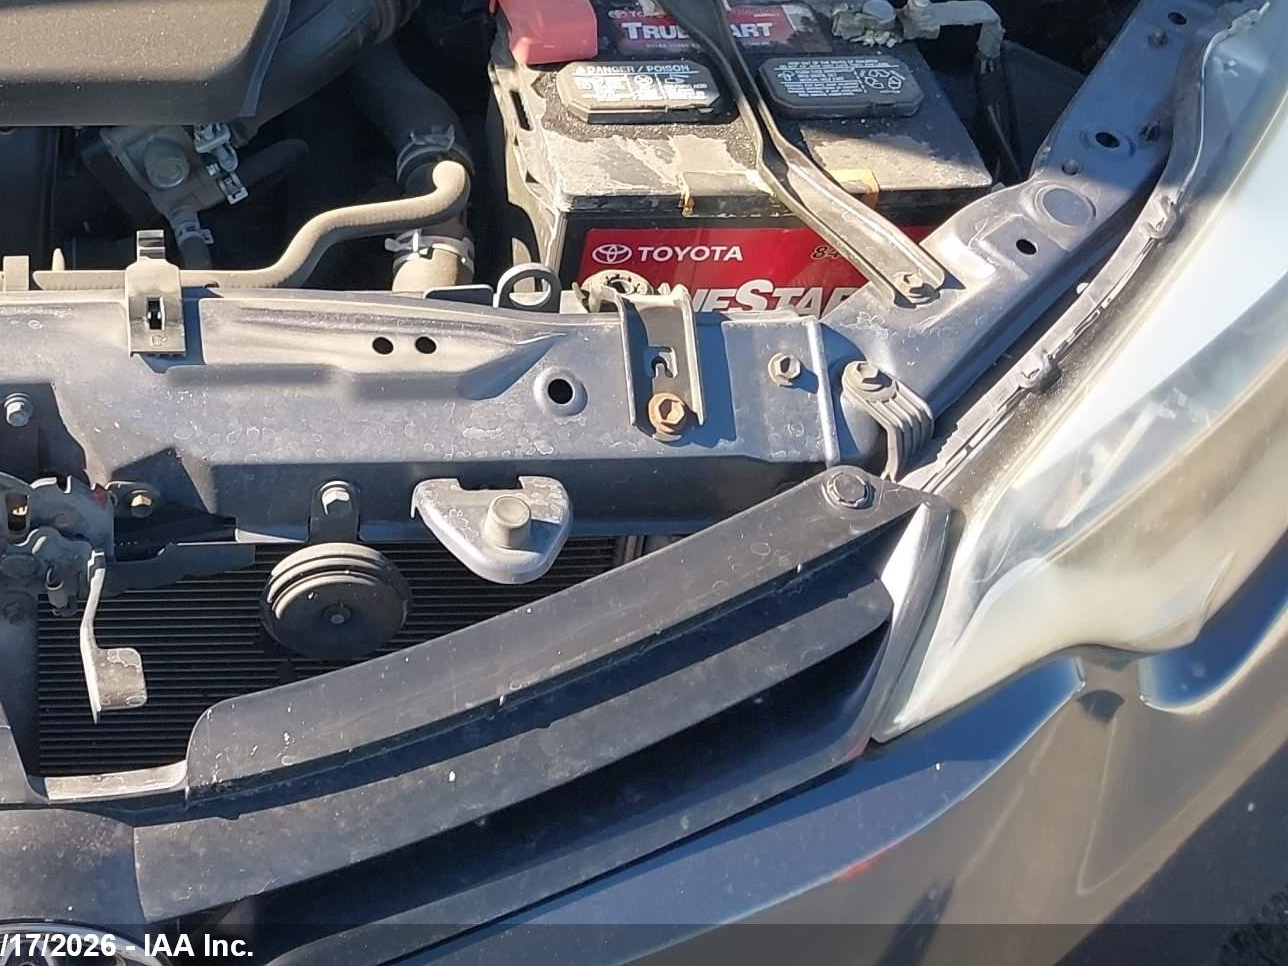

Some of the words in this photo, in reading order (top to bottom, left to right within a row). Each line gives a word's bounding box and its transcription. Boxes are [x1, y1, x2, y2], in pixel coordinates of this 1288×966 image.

[587, 65, 635, 74] DANGER
[646, 64, 690, 72] POISON
[638, 246, 743, 262] TOYOTA
